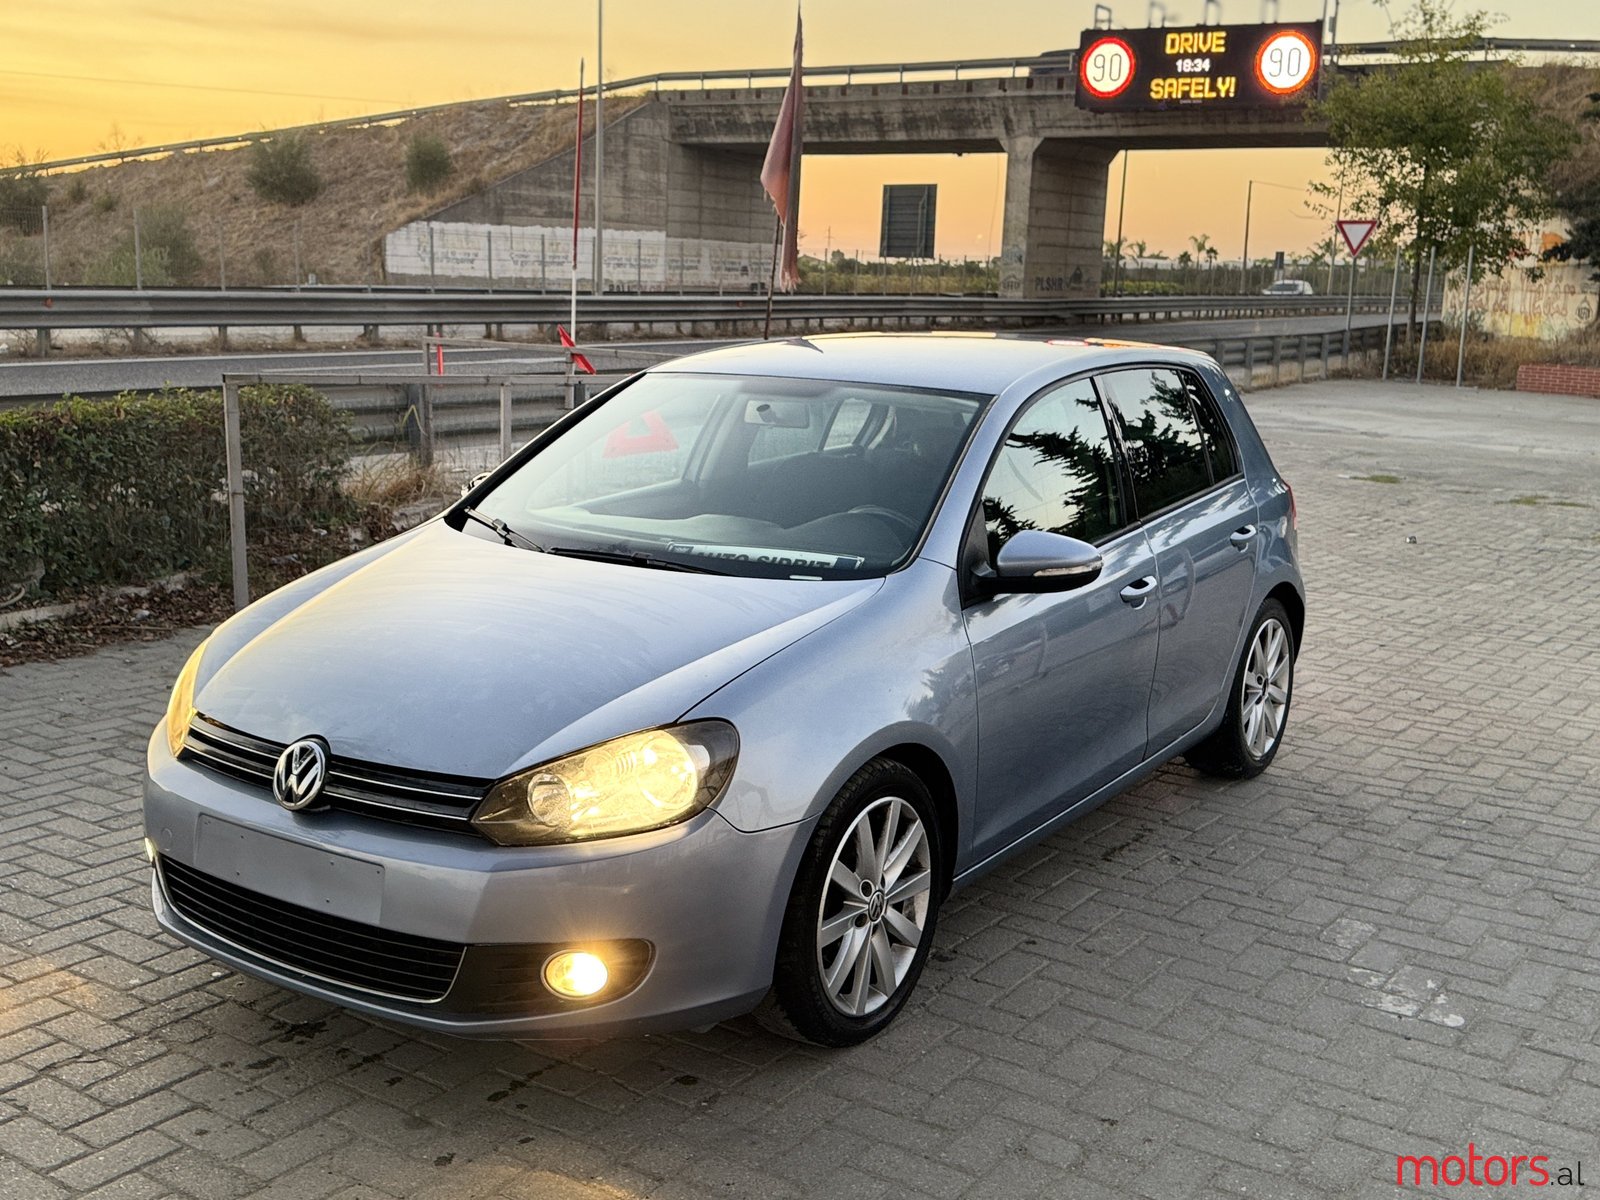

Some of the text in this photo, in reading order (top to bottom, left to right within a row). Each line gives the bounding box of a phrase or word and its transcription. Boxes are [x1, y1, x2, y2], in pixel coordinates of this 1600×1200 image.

[1165, 31, 1227, 54] DRIVE
[1093, 53, 1122, 82] 90
[1176, 58, 1211, 73] 18:34
[1269, 47, 1302, 77] 90
[1150, 76, 1236, 99] SAFELY!
